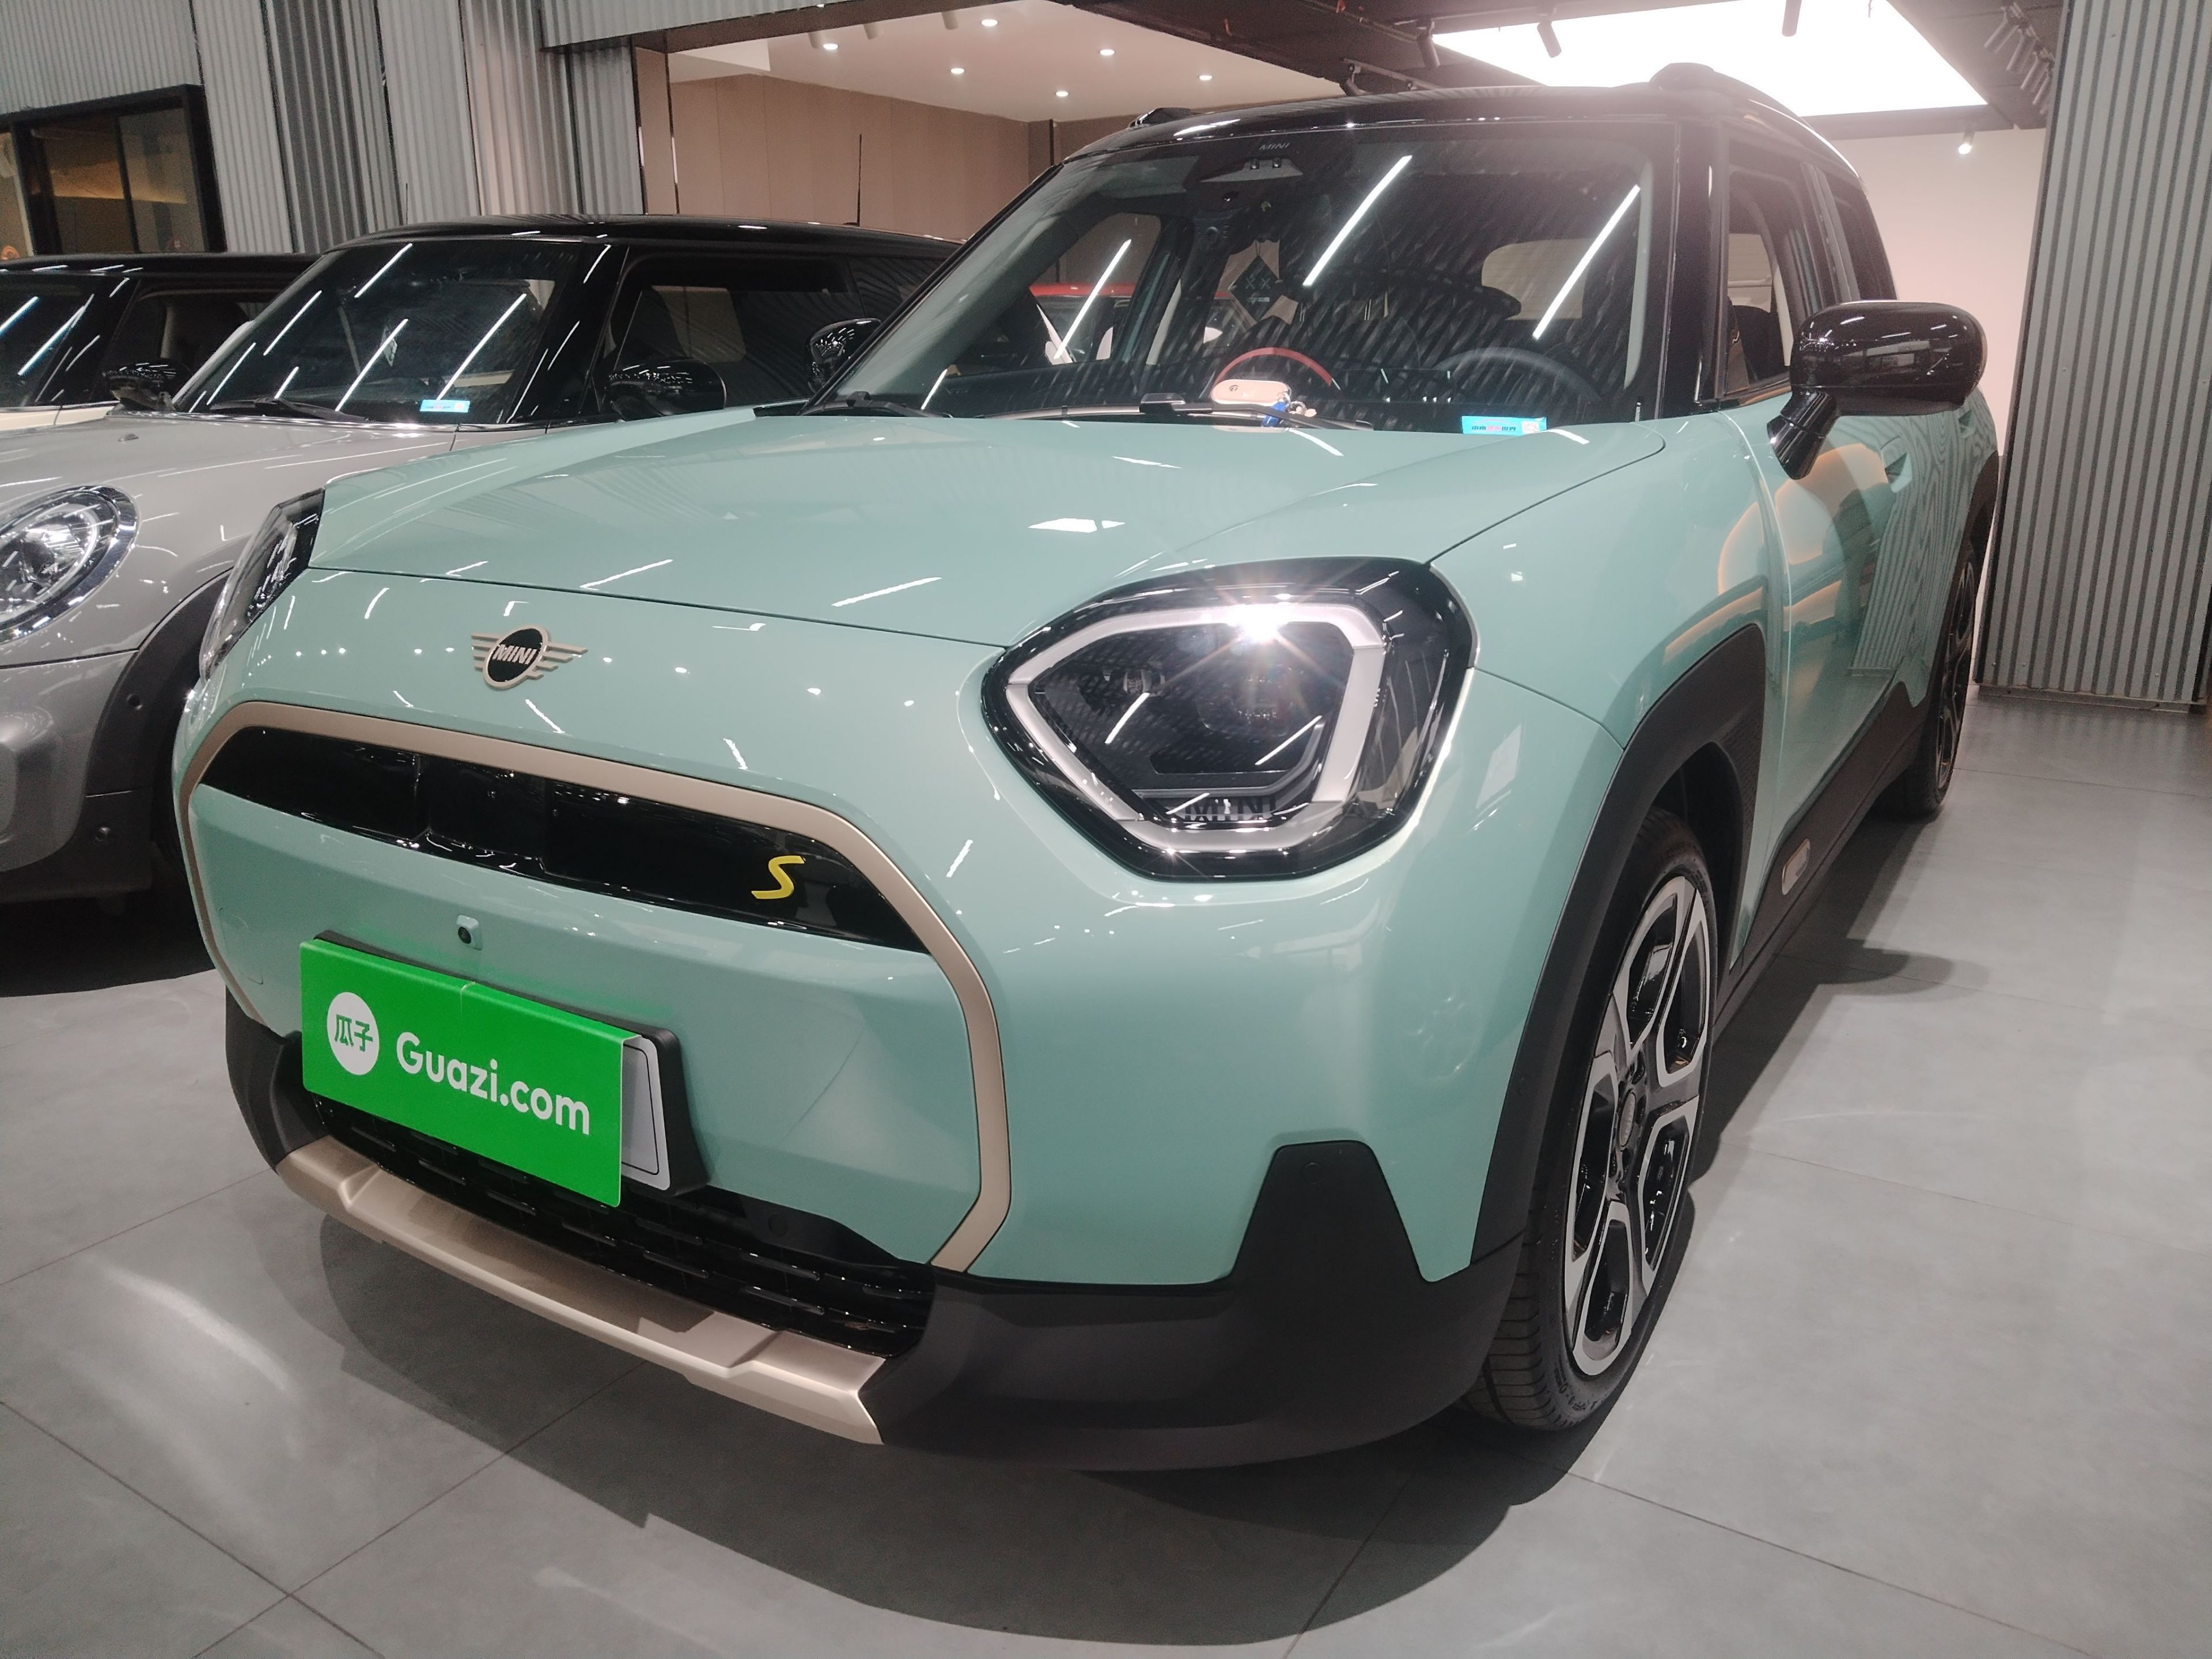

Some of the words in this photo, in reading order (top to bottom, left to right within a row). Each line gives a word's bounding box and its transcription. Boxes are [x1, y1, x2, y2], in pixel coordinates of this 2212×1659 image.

[492, 644, 537, 665] MINI
[751, 855, 805, 899] S
[334, 1013, 373, 1052] 瓜子
[396, 1031, 590, 1135] Guazi.com
